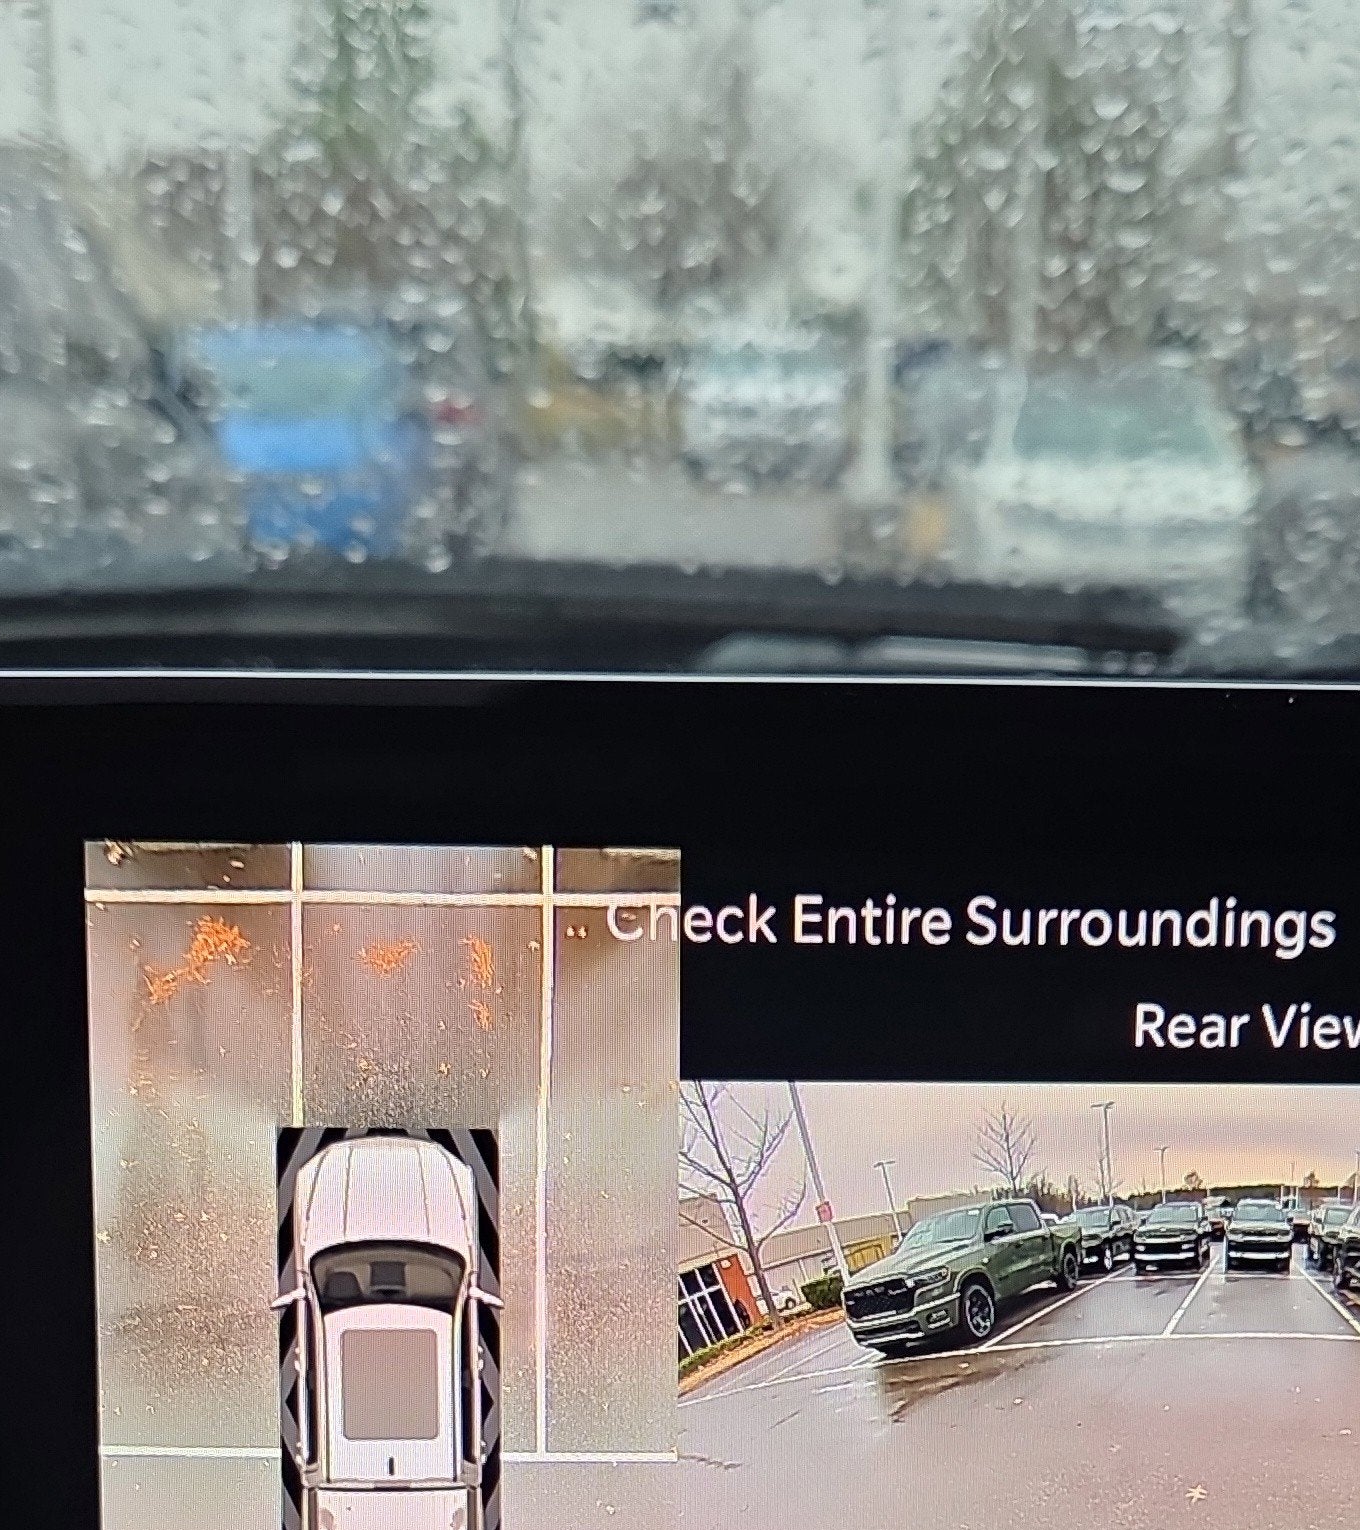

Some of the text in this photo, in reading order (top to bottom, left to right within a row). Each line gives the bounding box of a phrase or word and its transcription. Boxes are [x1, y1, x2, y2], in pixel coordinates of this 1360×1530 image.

[606, 892, 1337, 960] Check Entire Surroundings
[1134, 1002, 1251, 1049] Rear
